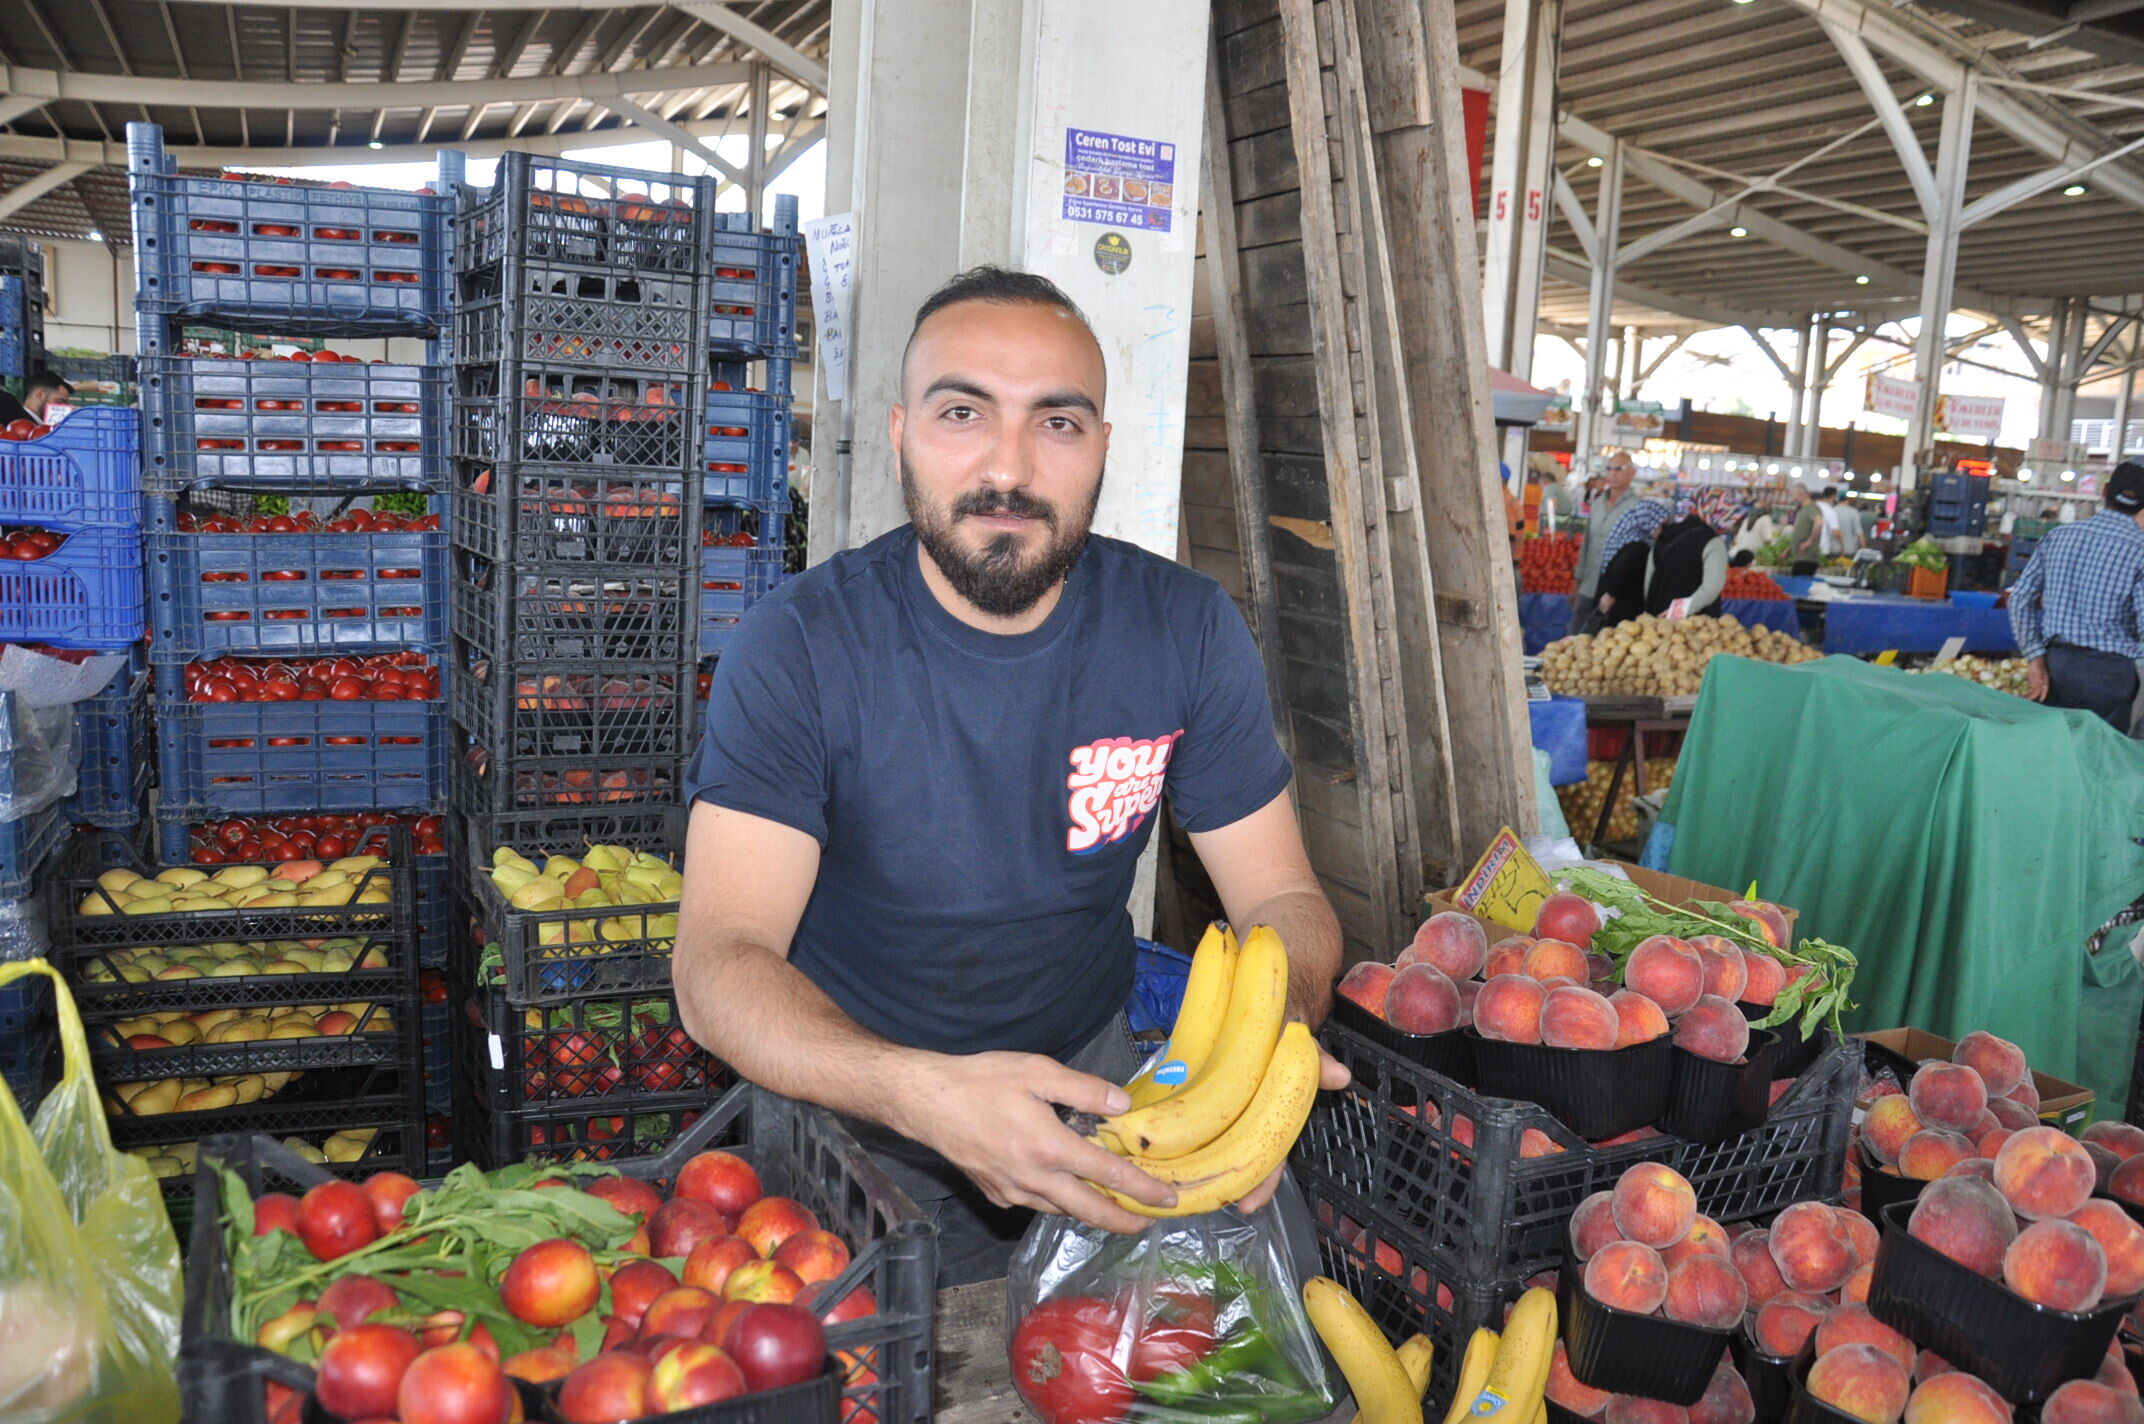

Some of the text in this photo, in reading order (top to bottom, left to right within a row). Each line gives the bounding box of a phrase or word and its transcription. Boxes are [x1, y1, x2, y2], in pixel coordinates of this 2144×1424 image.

[1076, 132, 1109, 150] Ceren
[1111, 138, 1137, 154] Tost
[1138, 142, 1156, 157] Evi
[1067, 205, 1143, 226] 0531 575 67 45
[1496, 190, 1507, 221] 5
[1528, 190, 1543, 221] 5
